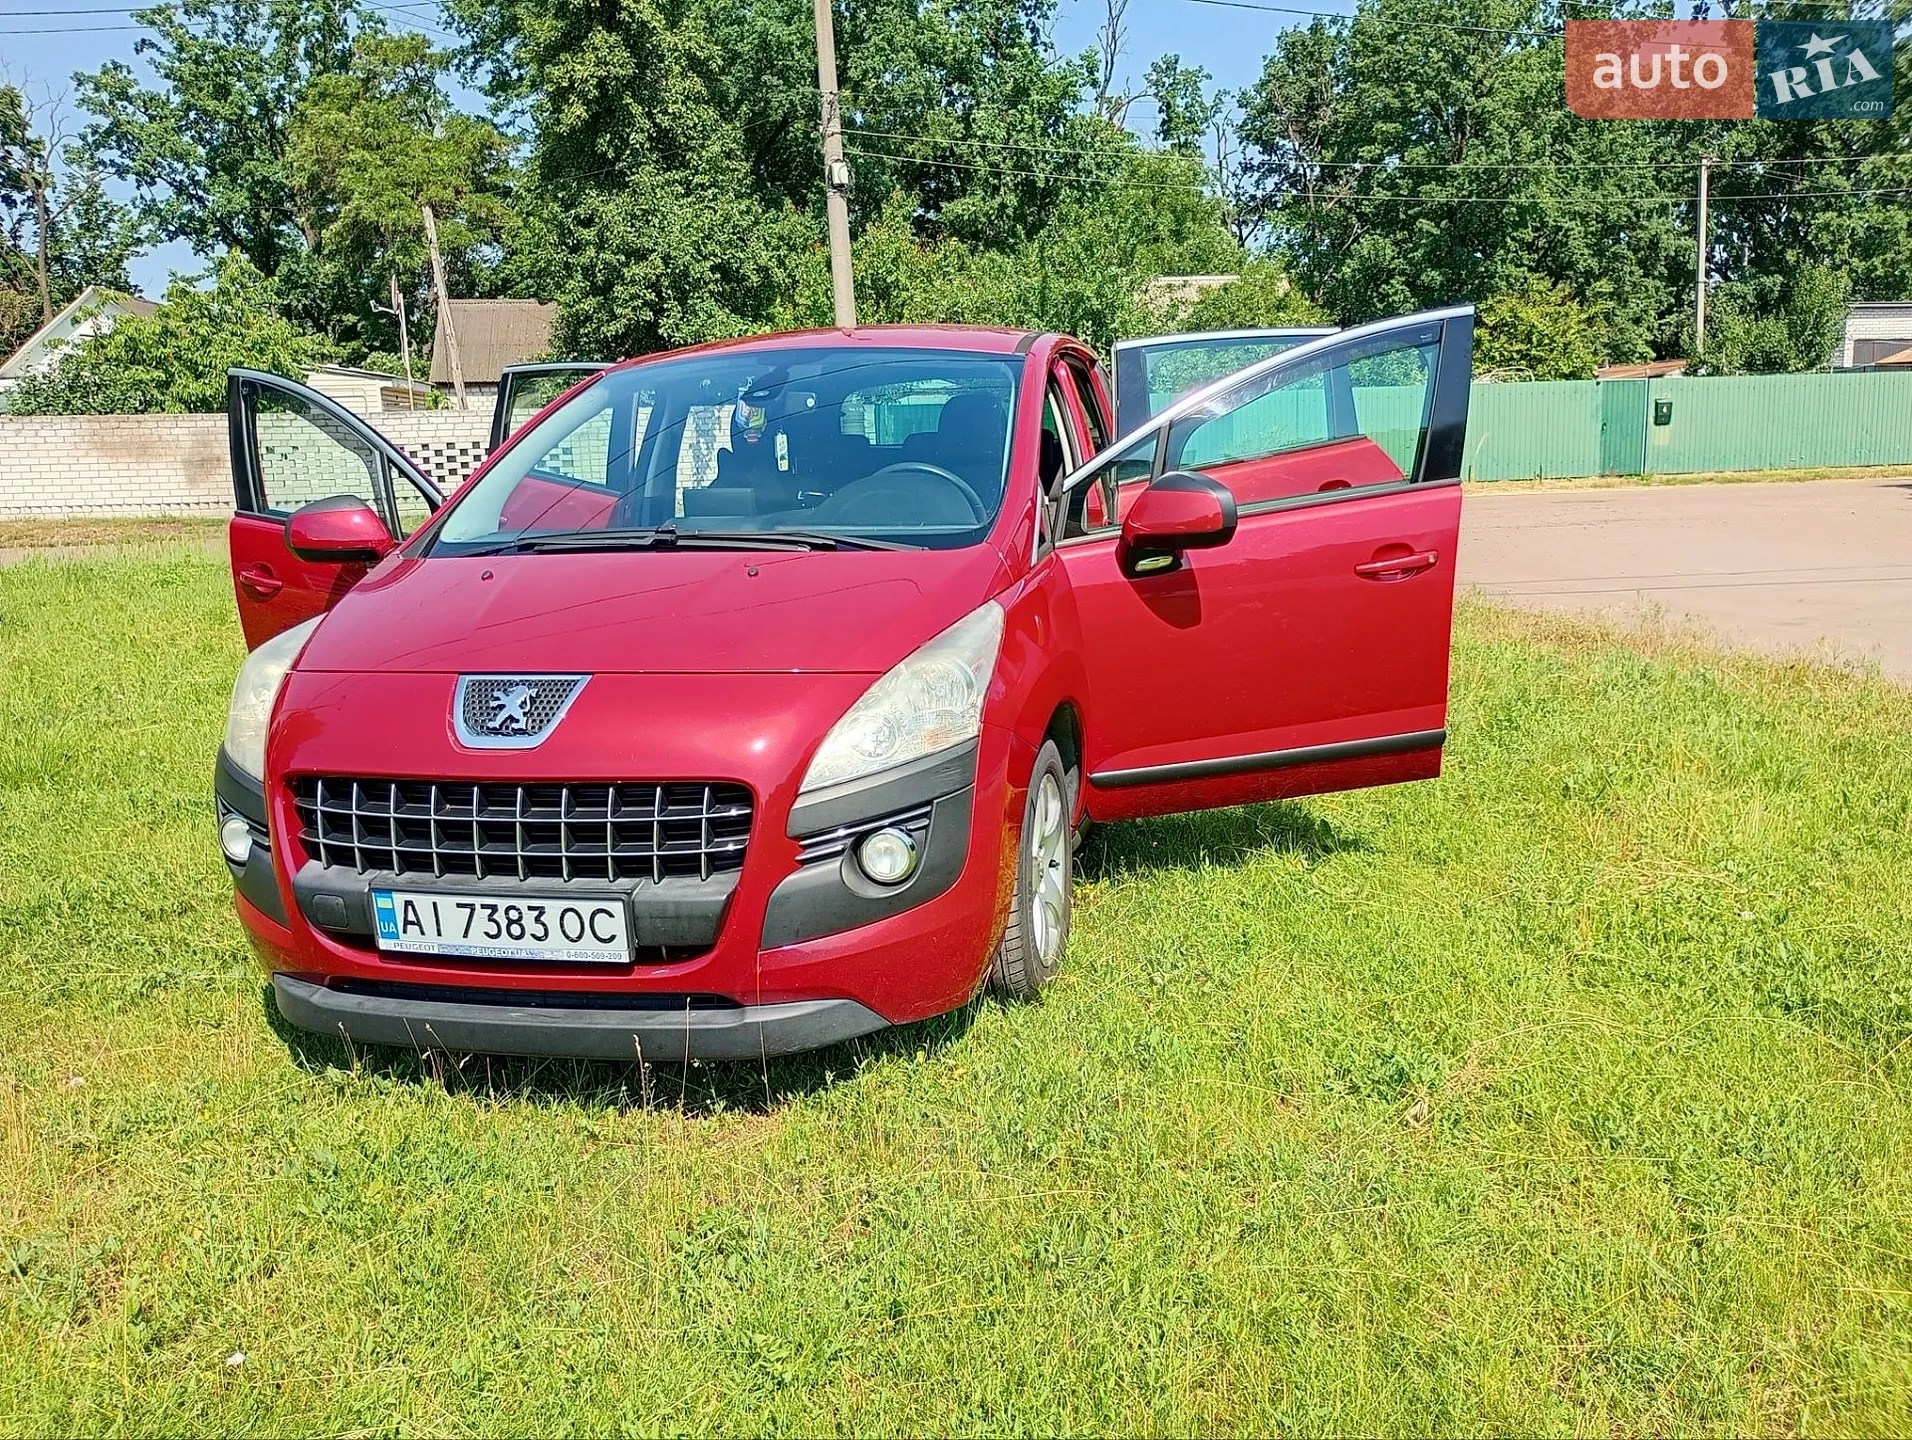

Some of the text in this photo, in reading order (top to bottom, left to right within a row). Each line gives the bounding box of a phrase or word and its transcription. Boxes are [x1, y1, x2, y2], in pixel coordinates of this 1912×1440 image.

[380, 922, 398, 935] UA
[402, 900, 618, 944] AI 7383 OC
[393, 942, 436, 952] PEUGEOT
